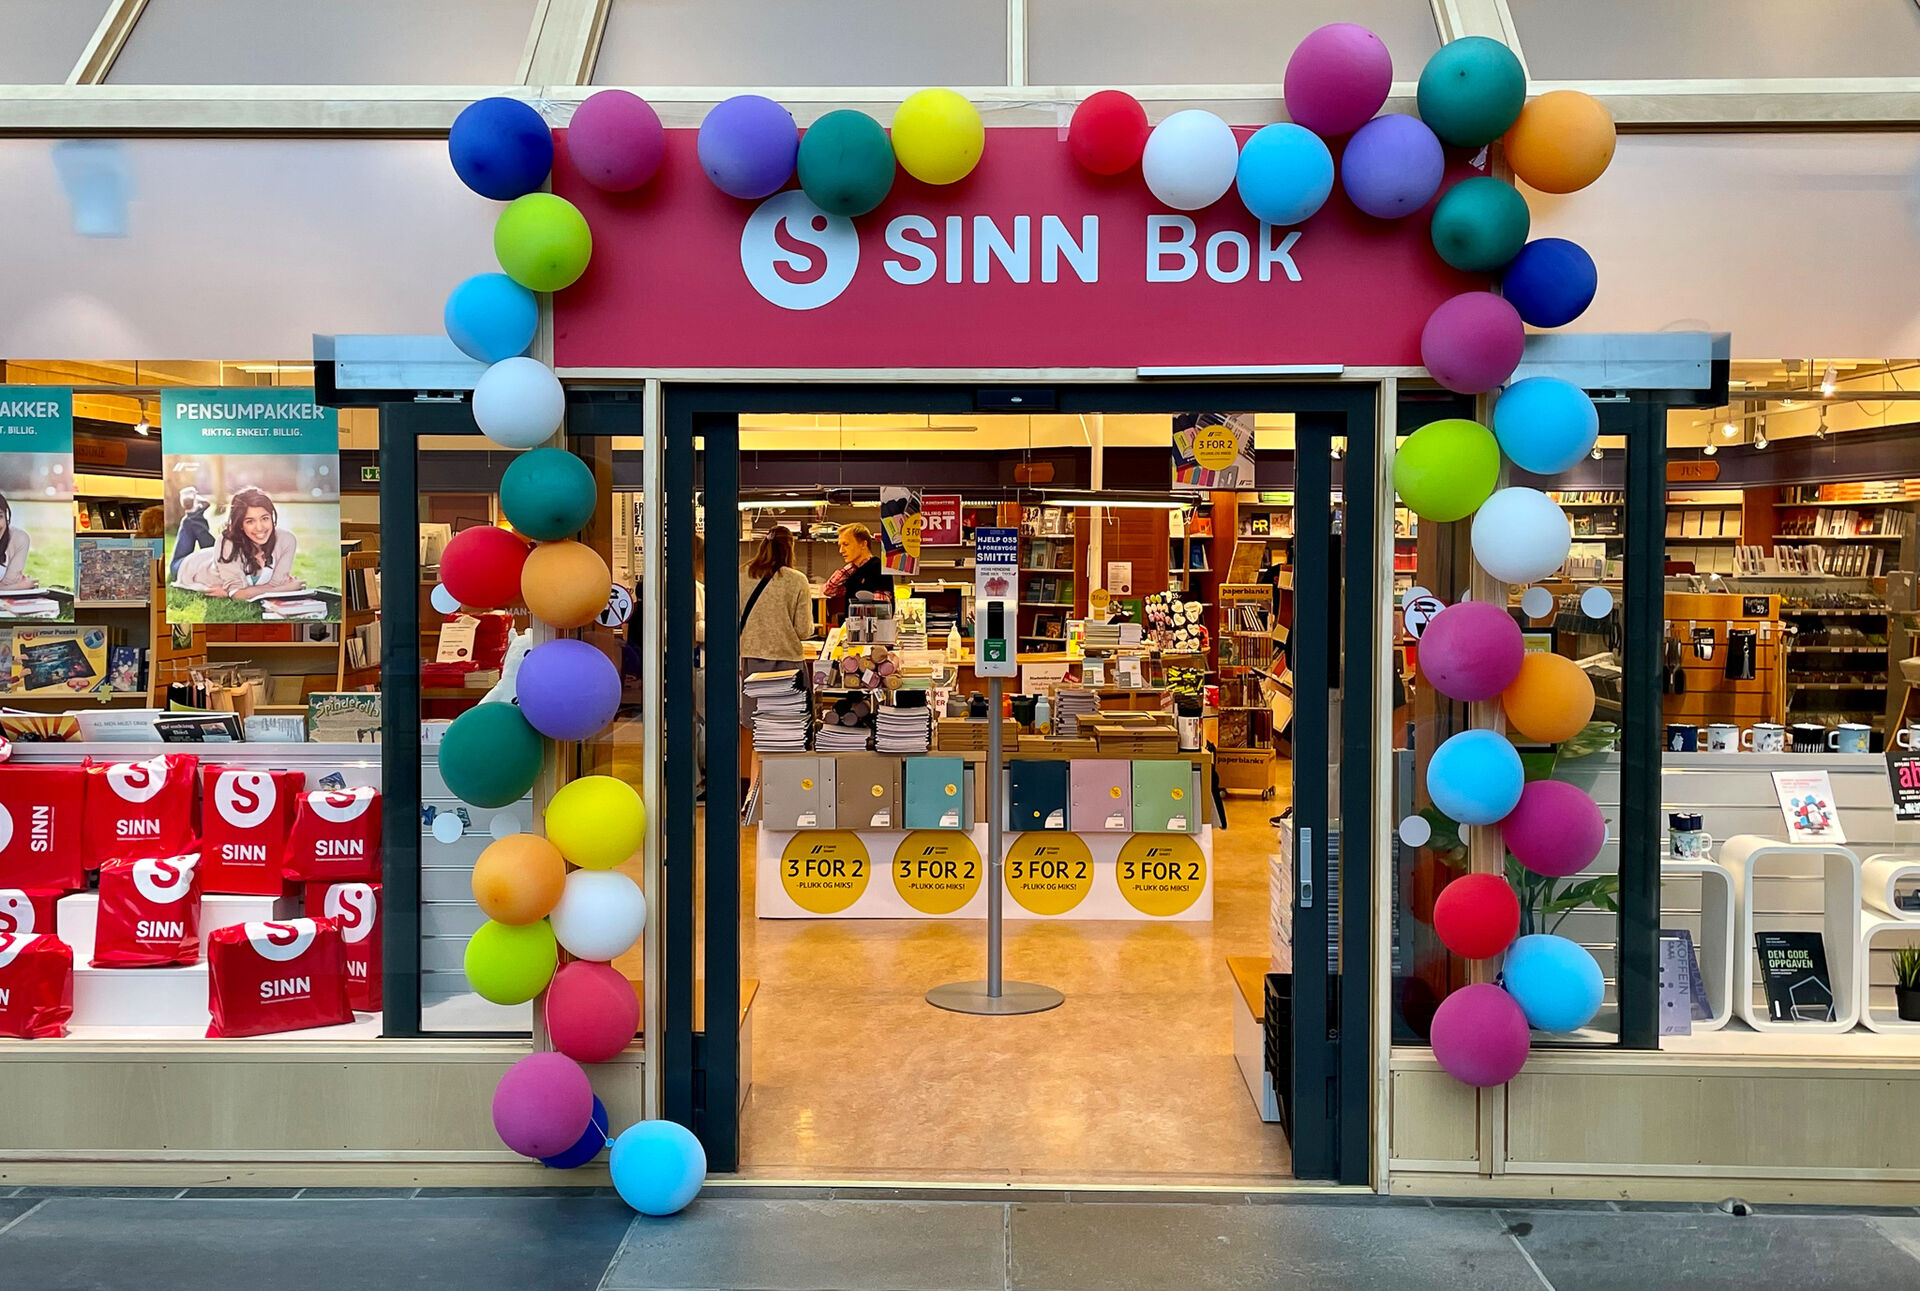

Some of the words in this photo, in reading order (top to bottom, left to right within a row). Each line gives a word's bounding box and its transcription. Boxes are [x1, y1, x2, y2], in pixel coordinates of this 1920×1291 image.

[883, 214, 1099, 285] SINN
[1146, 214, 1302, 283] Bok
[0, 401, 59, 418] AKKER
[176, 403, 325, 420] PENSUMPAKKER
[8, 426, 37, 435] BILLIG.
[202, 428, 235, 437] RIKTIG.
[236, 428, 271, 437] ENKELT.
[273, 428, 303, 437] BILLIG.
[1199, 441, 1204, 449] 3
[1207, 441, 1224, 449] FOR
[1227, 441, 1232, 449] 2
[920, 516, 955, 530] ORT
[977, 553, 1017, 562] SMITTE
[1222, 587, 1270, 596] paperblanks
[505, 603, 530, 615] MAN-
[1217, 756, 1264, 765] paperblanks
[1899, 760, 1920, 788] ab
[31, 806, 49, 852] SINN
[116, 819, 160, 836] SINN
[222, 844, 266, 861] SINN
[315, 839, 364, 856] SINN
[788, 859, 799, 877] 3
[806, 859, 846, 877] FOR
[851, 859, 863, 877] 2
[900, 860, 911, 878] 3
[918, 860, 958, 879] FOR
[963, 861, 975, 879] 2
[1011, 861, 1023, 879] 3
[1029, 861, 1069, 879] FOR
[1075, 861, 1087, 879] 2
[1123, 862, 1135, 879] 3
[1141, 862, 1182, 880] FOR
[1188, 863, 1199, 880] 2
[136, 920, 184, 938] SINN
[1767, 950, 1785, 959] DEN
[1787, 950, 1809, 959] GODE
[347, 961, 367, 978] NN
[1677, 940, 1689, 995] KOFFEIN
[1769, 959, 1813, 968] OPPGAVEN
[260, 976, 311, 998] SINN
